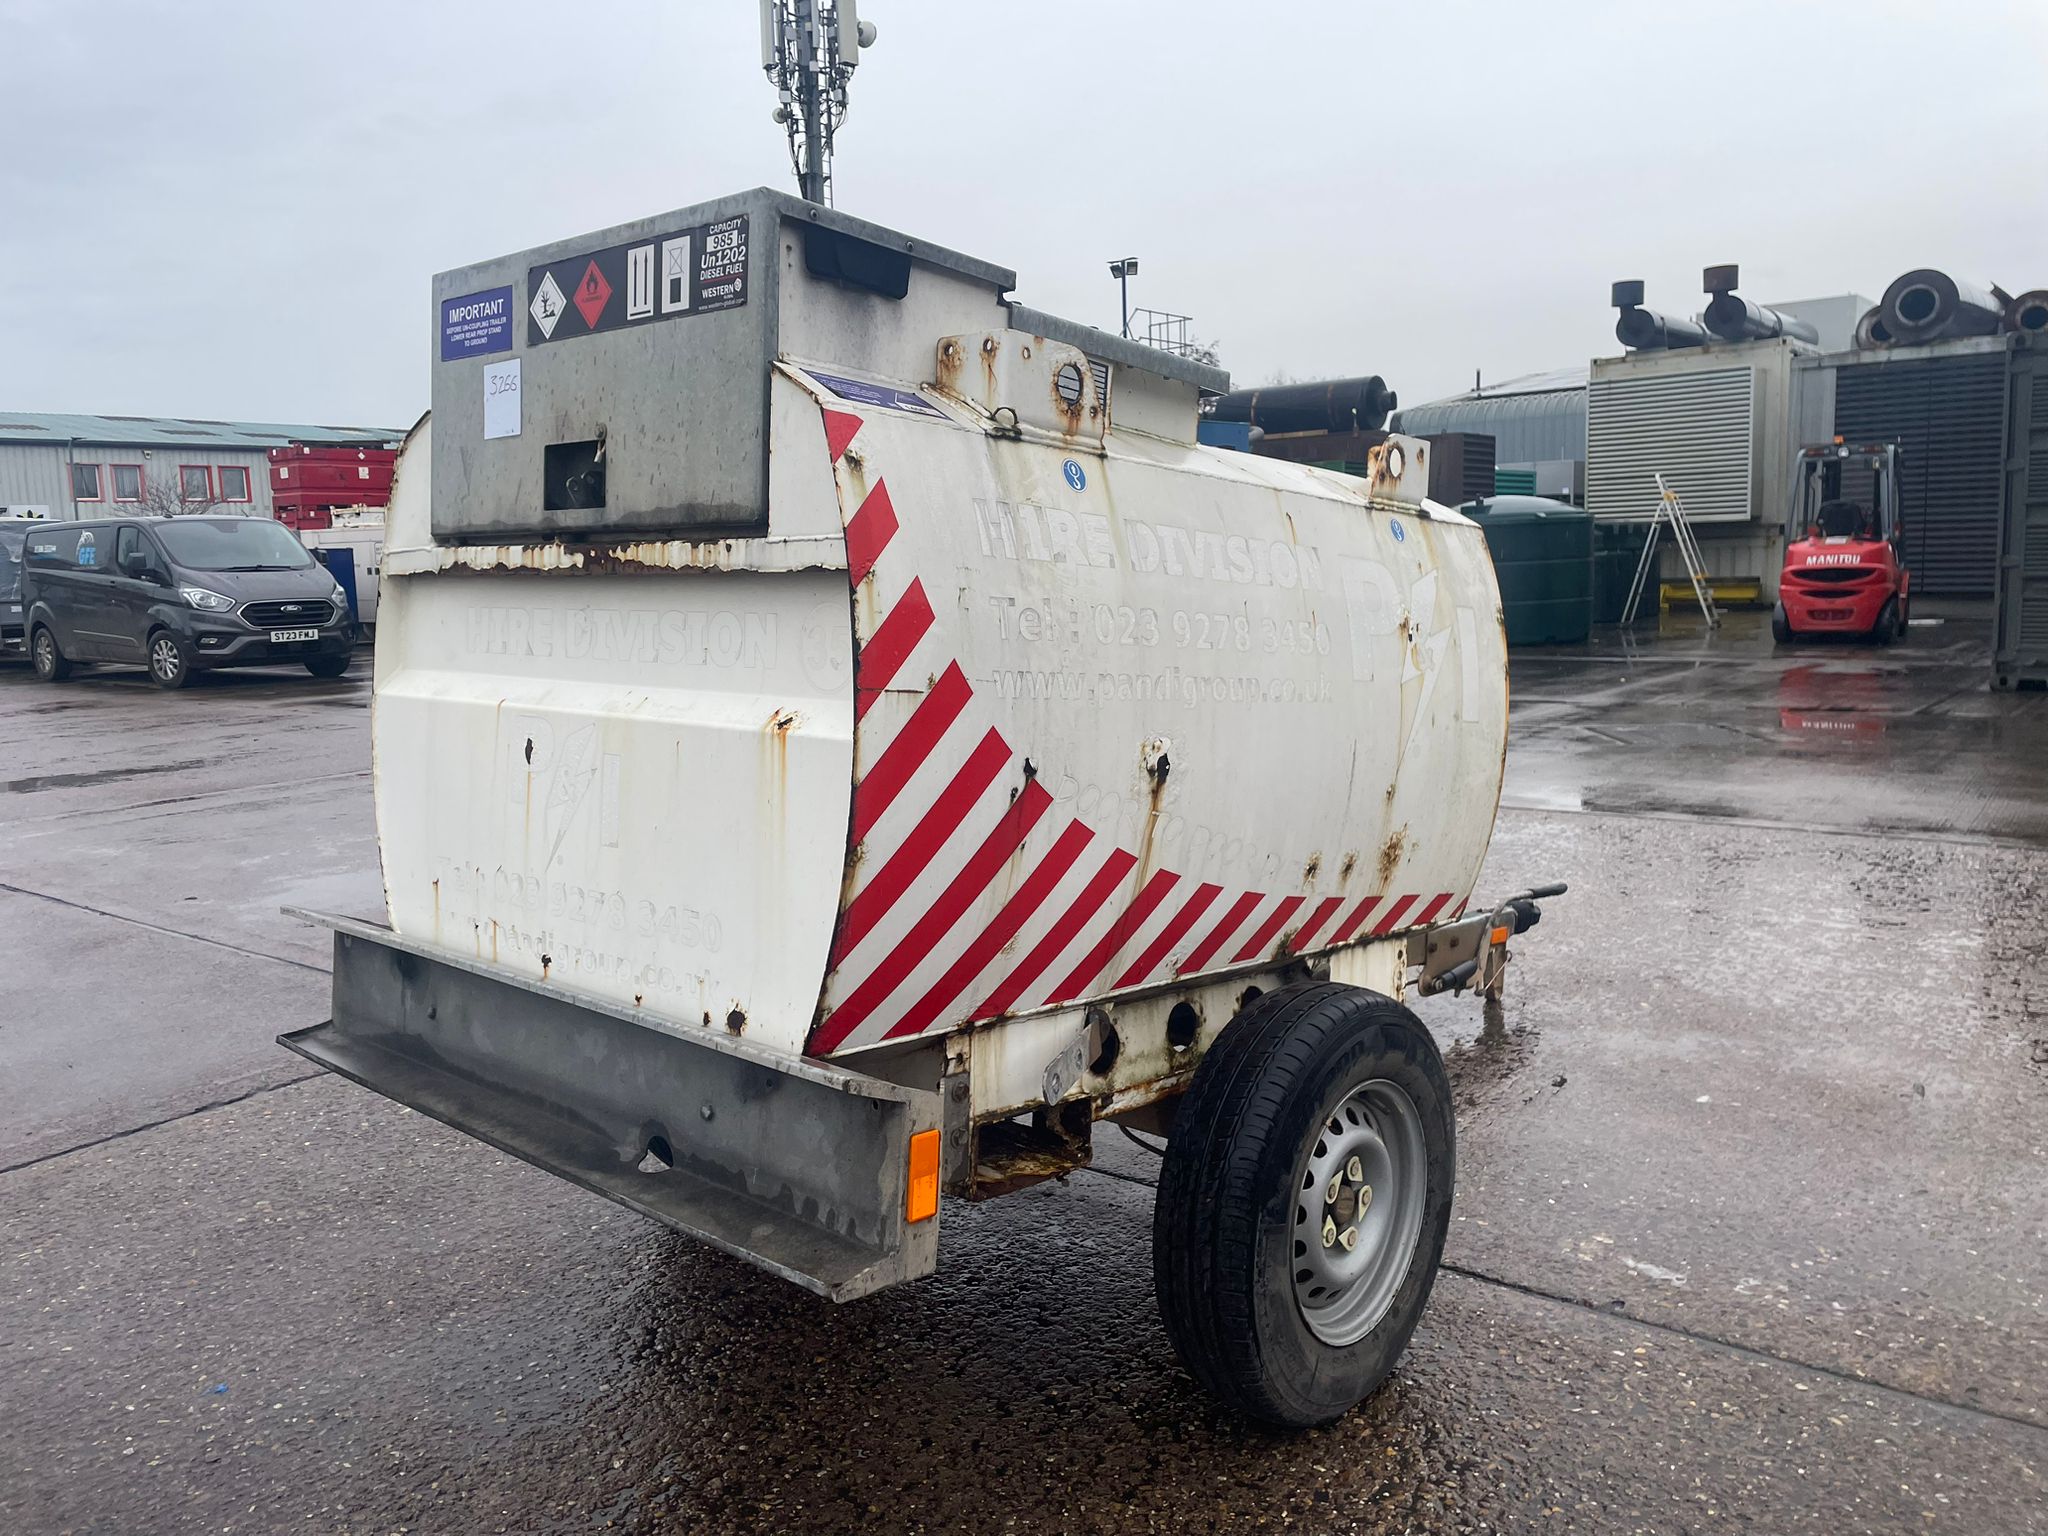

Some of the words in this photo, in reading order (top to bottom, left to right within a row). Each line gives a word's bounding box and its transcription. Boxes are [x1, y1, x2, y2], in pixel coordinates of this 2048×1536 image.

[709, 218, 743, 235] CAPACITY
[713, 233, 733, 250] 985
[738, 233, 746, 244] LT
[701, 245, 746, 269] Un1202
[700, 268, 724, 280] DIESEL
[725, 262, 744, 275] FUEL
[701, 284, 734, 299] WESTERN
[449, 299, 504, 324] IMPORTANT
[446, 325, 462, 335] BEFORE
[489, 316, 506, 326] TRAILER
[450, 333, 465, 342] LOWER
[465, 331, 477, 339] REAR
[488, 326, 502, 335] STAND
[489, 374, 518, 396] 3266
[972, 498, 1116, 568] HIRE
[1123, 518, 1325, 592] DIVISION
[1806, 554, 1861, 567] MANITOU
[274, 631, 297, 641] ST23
[467, 606, 553, 657] HIRE
[564, 606, 778, 670] DIVISION
[1094, 603, 1161, 648] 023
[1172, 609, 1251, 653] 9278
[1261, 617, 1332, 656] 3450
